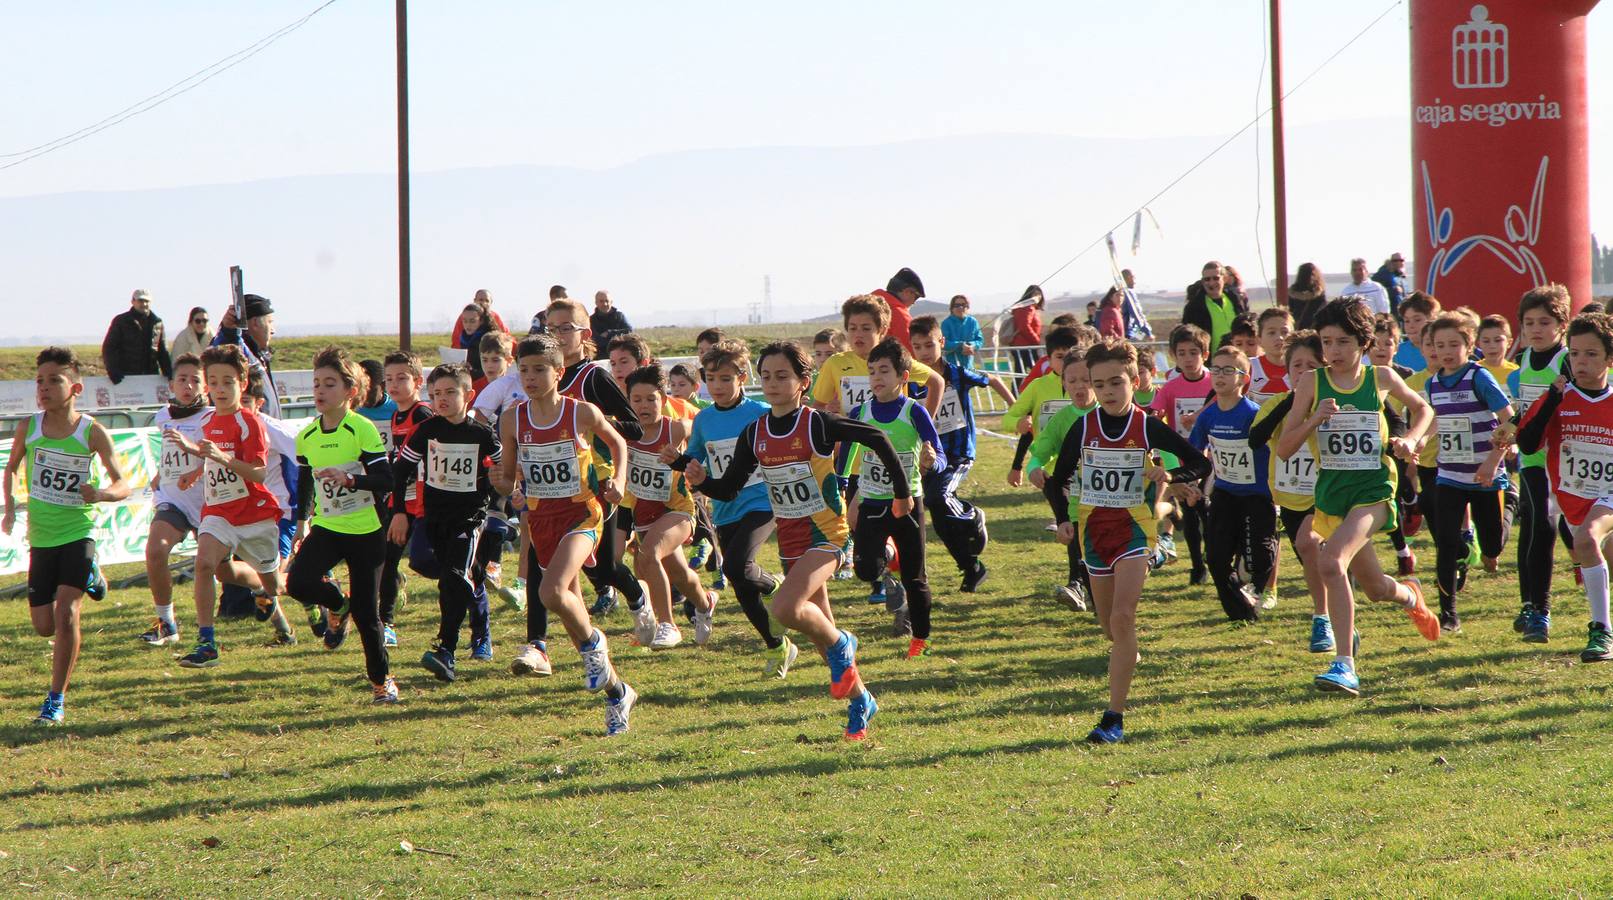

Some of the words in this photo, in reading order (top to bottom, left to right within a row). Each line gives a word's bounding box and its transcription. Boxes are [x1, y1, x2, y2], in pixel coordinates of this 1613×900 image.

[1416, 98, 1455, 128] caja
[1459, 94, 1561, 127] segovia
[1328, 432, 1373, 455] 696
[432, 455, 473, 475] 1148
[1214, 449, 1249, 468] 1574
[40, 469, 80, 492] 652
[207, 467, 238, 487] 348
[530, 462, 571, 484] 608
[630, 466, 665, 489] 605
[1090, 469, 1136, 492] 607
[770, 481, 811, 505] 610
